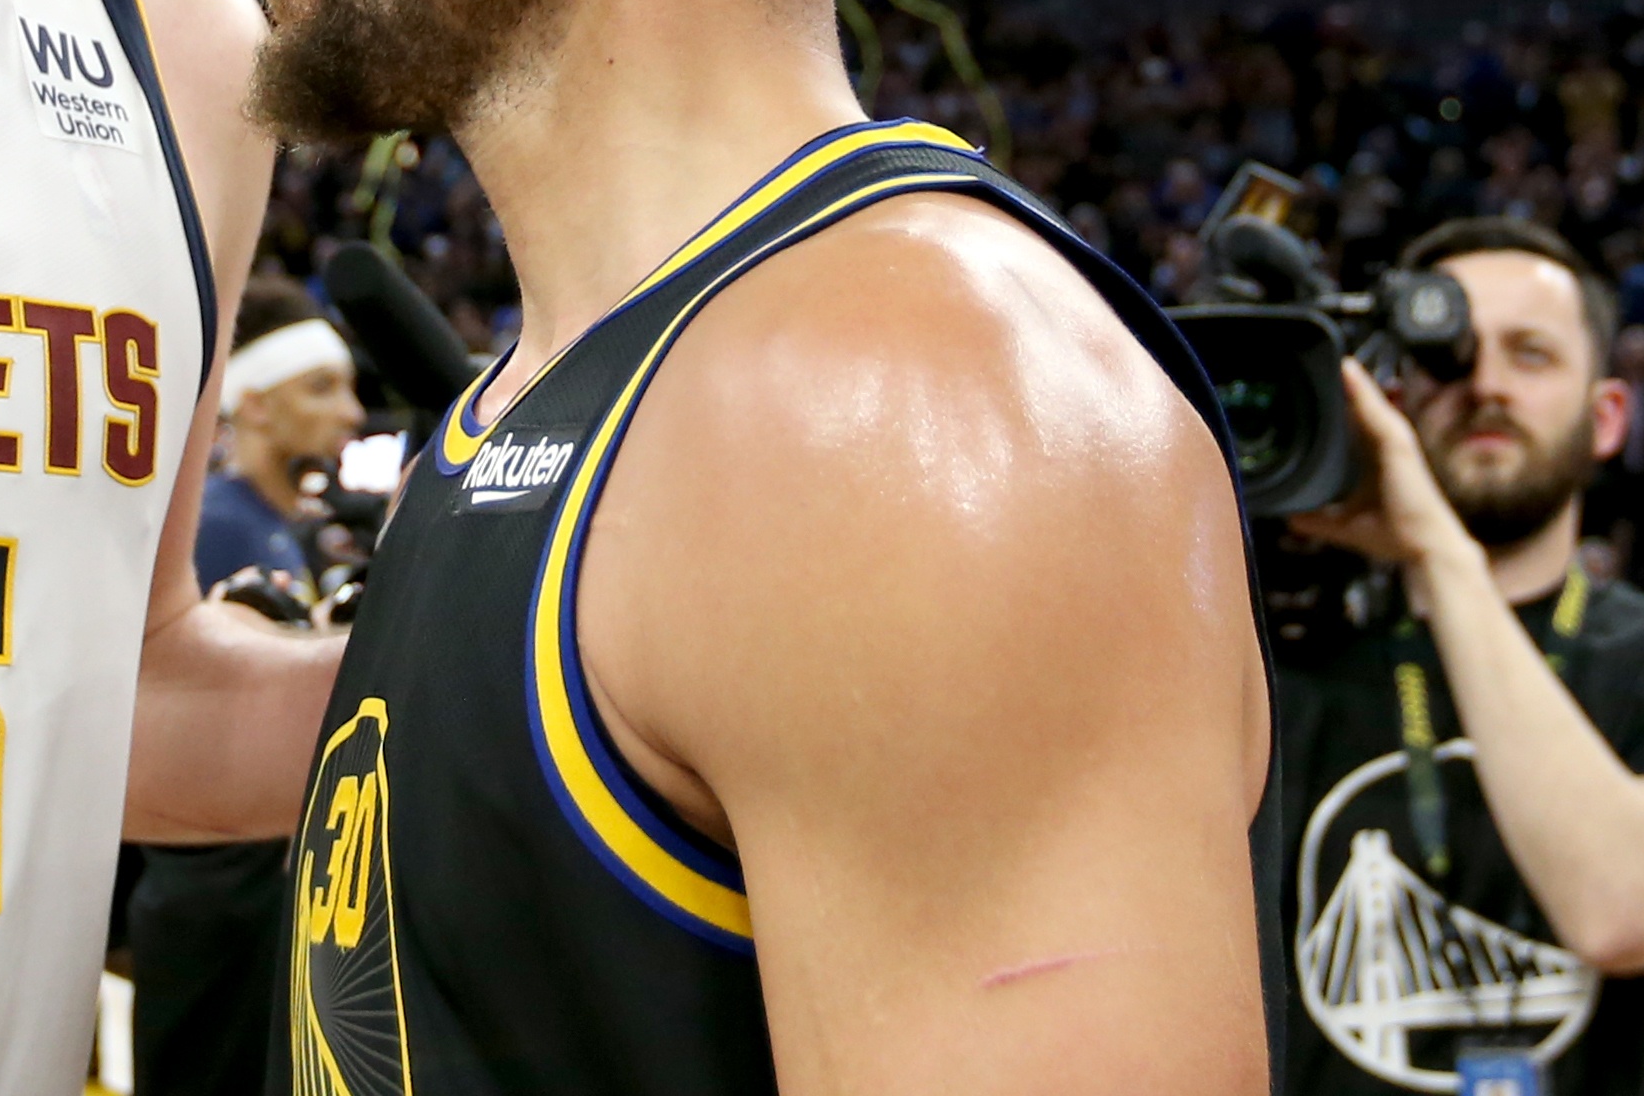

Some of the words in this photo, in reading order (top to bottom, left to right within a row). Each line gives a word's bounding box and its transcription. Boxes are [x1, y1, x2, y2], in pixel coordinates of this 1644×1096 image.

[19, 15, 114, 89] WU
[32, 81, 129, 122] Western
[56, 111, 124, 145] Union
[462, 432, 574, 490] Rakuten
[310, 771, 377, 949] 30
